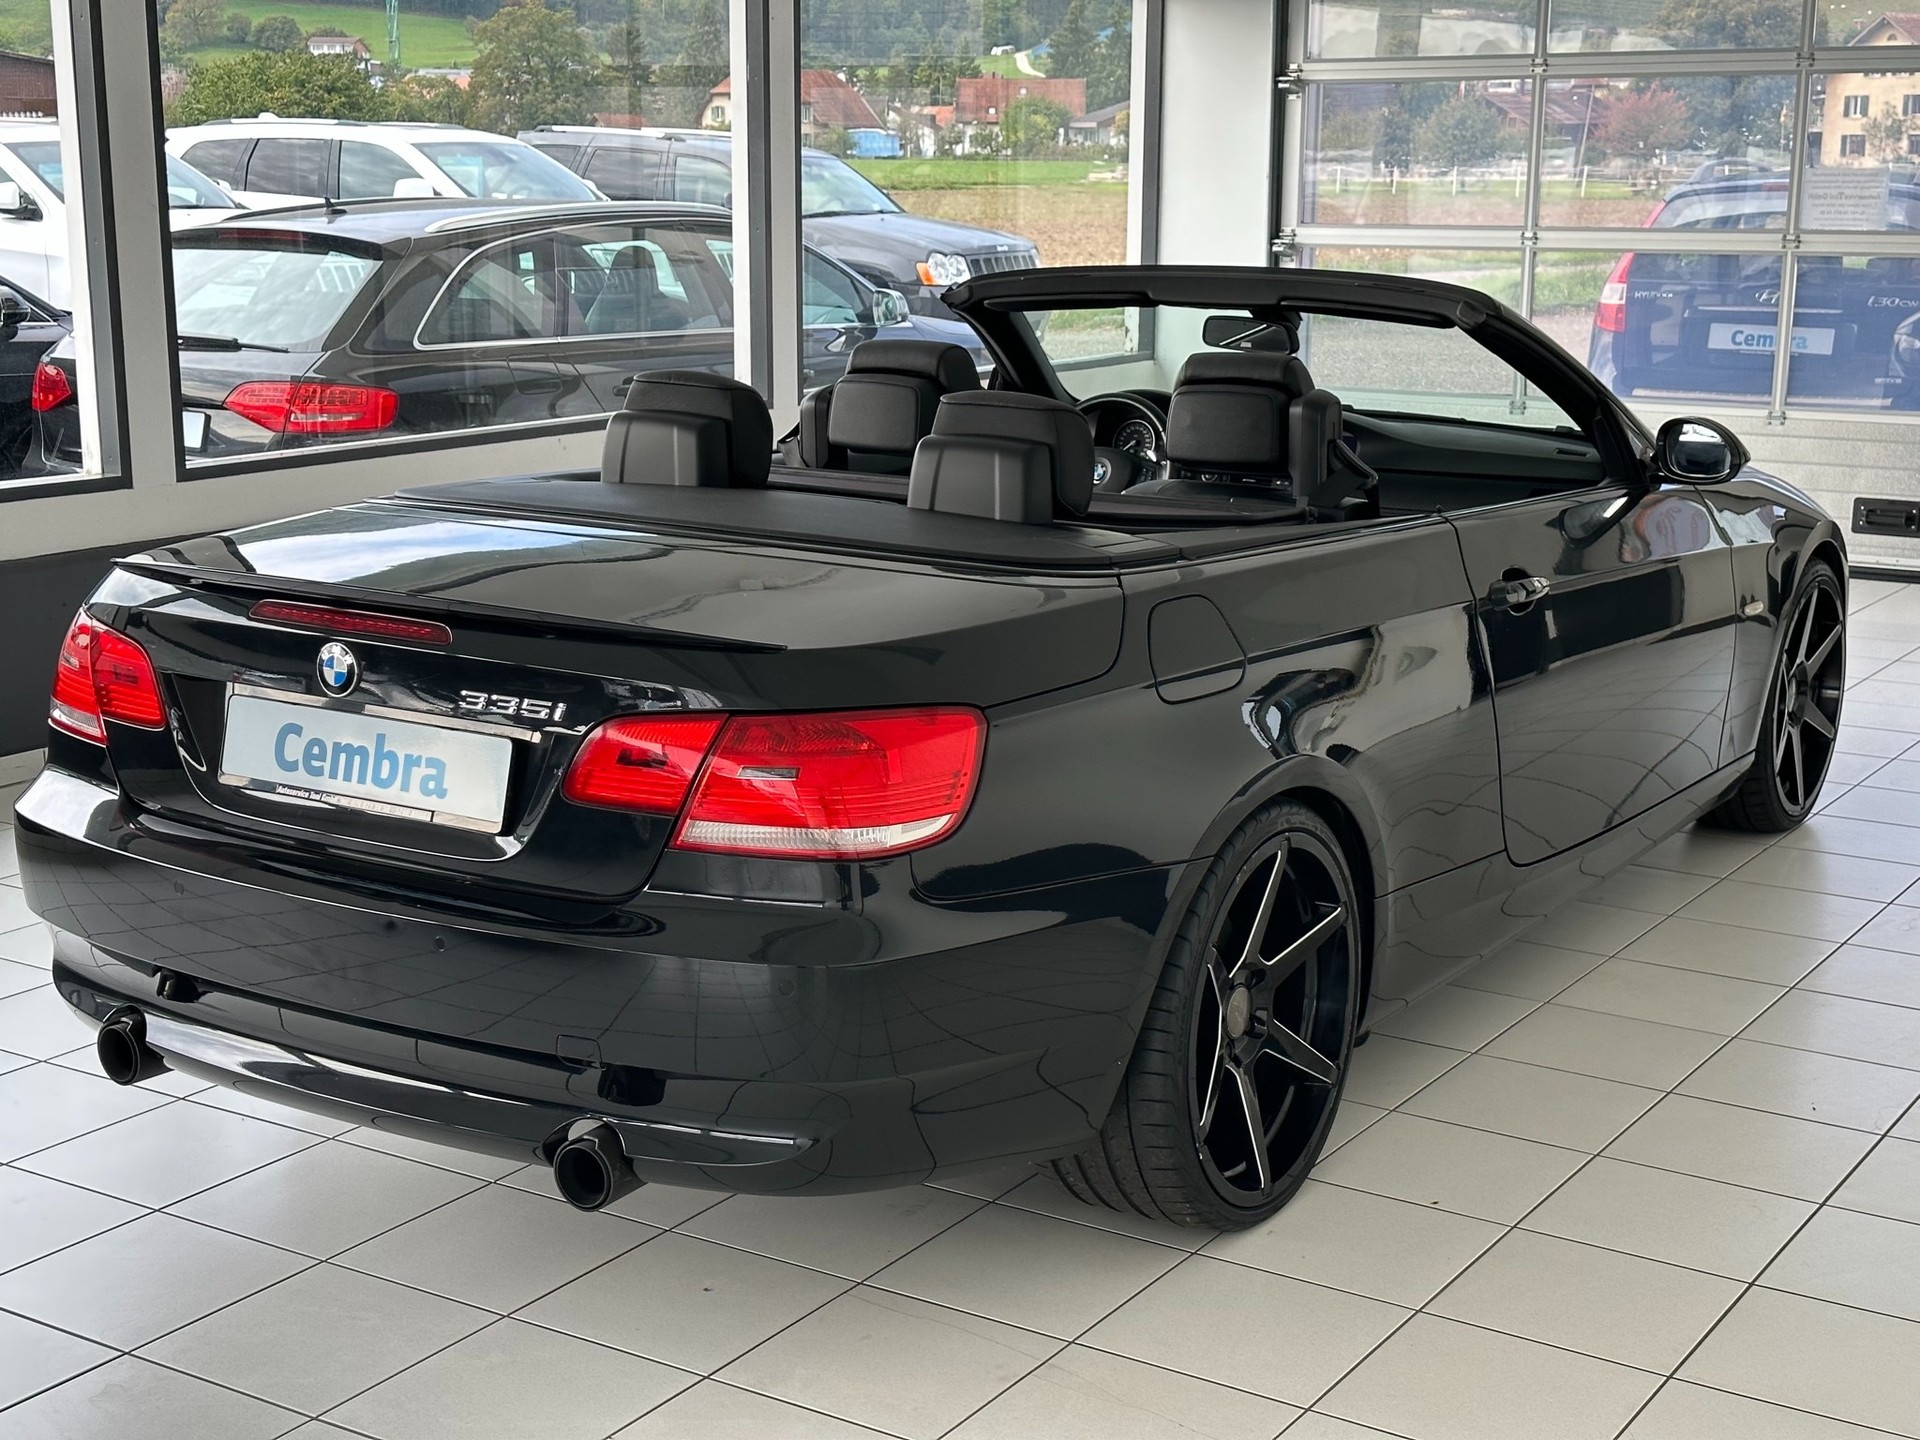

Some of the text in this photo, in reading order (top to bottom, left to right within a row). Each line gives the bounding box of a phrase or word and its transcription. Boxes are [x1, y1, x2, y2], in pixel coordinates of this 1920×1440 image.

[1731, 330, 1808, 350] Cema
[459, 690, 567, 721] 335i
[274, 722, 448, 800] Cembra
